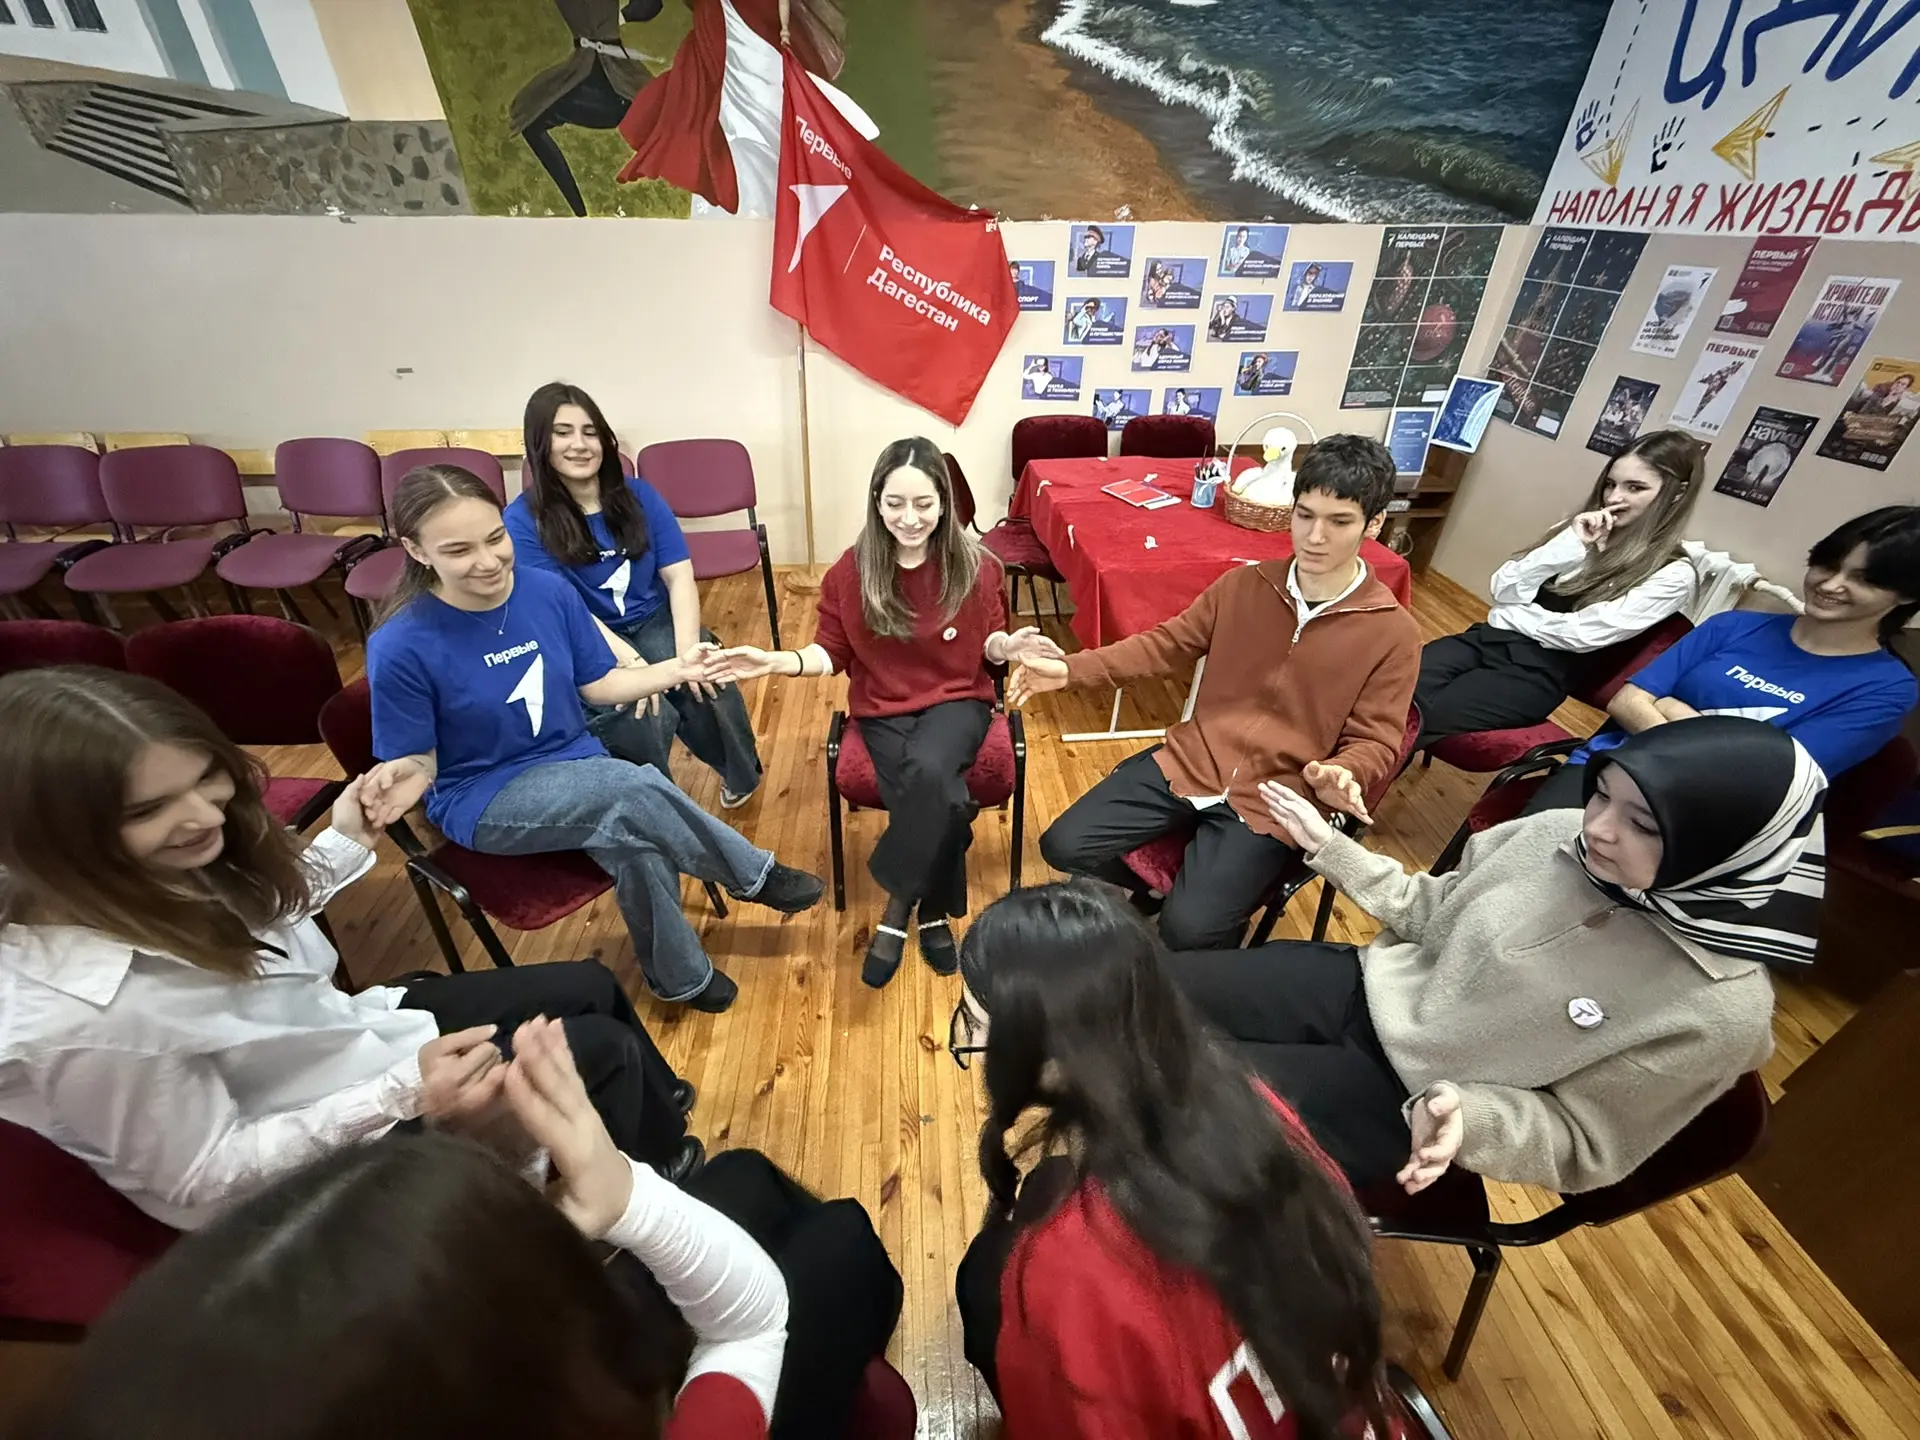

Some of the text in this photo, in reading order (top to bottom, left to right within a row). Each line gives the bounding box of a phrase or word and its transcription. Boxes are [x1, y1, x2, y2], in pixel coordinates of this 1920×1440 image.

[795, 115, 853, 180] Первые
[1704, 173, 1858, 234] ЖИЗНЬ
[1752, 248, 1800, 260] ПЕРВЫЙ
[866, 267, 959, 332] Дагестан
[879, 244, 991, 325] Республика
[1017, 295, 1039, 303] СПОРТ
[1705, 342, 1759, 359] ПЕРВЫЕ
[483, 639, 540, 668] Первые
[1725, 664, 1805, 704] Первые
